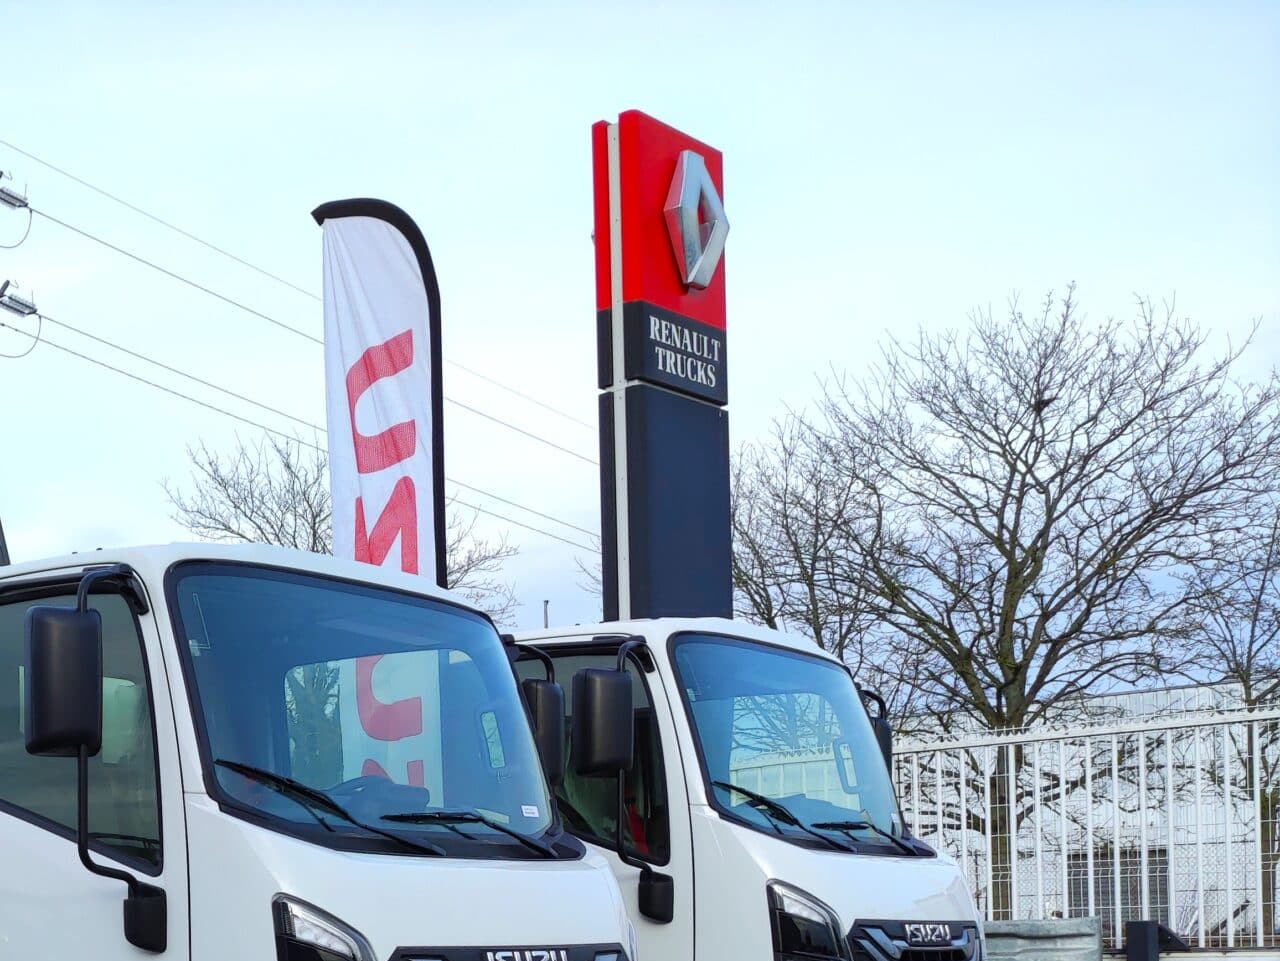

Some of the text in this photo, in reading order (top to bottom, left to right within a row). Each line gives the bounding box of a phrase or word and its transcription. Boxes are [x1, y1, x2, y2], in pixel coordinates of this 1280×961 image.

[649, 315, 720, 361] RENAULT
[655, 346, 716, 388] TRUCKS
[905, 924, 951, 943] ISUZU
